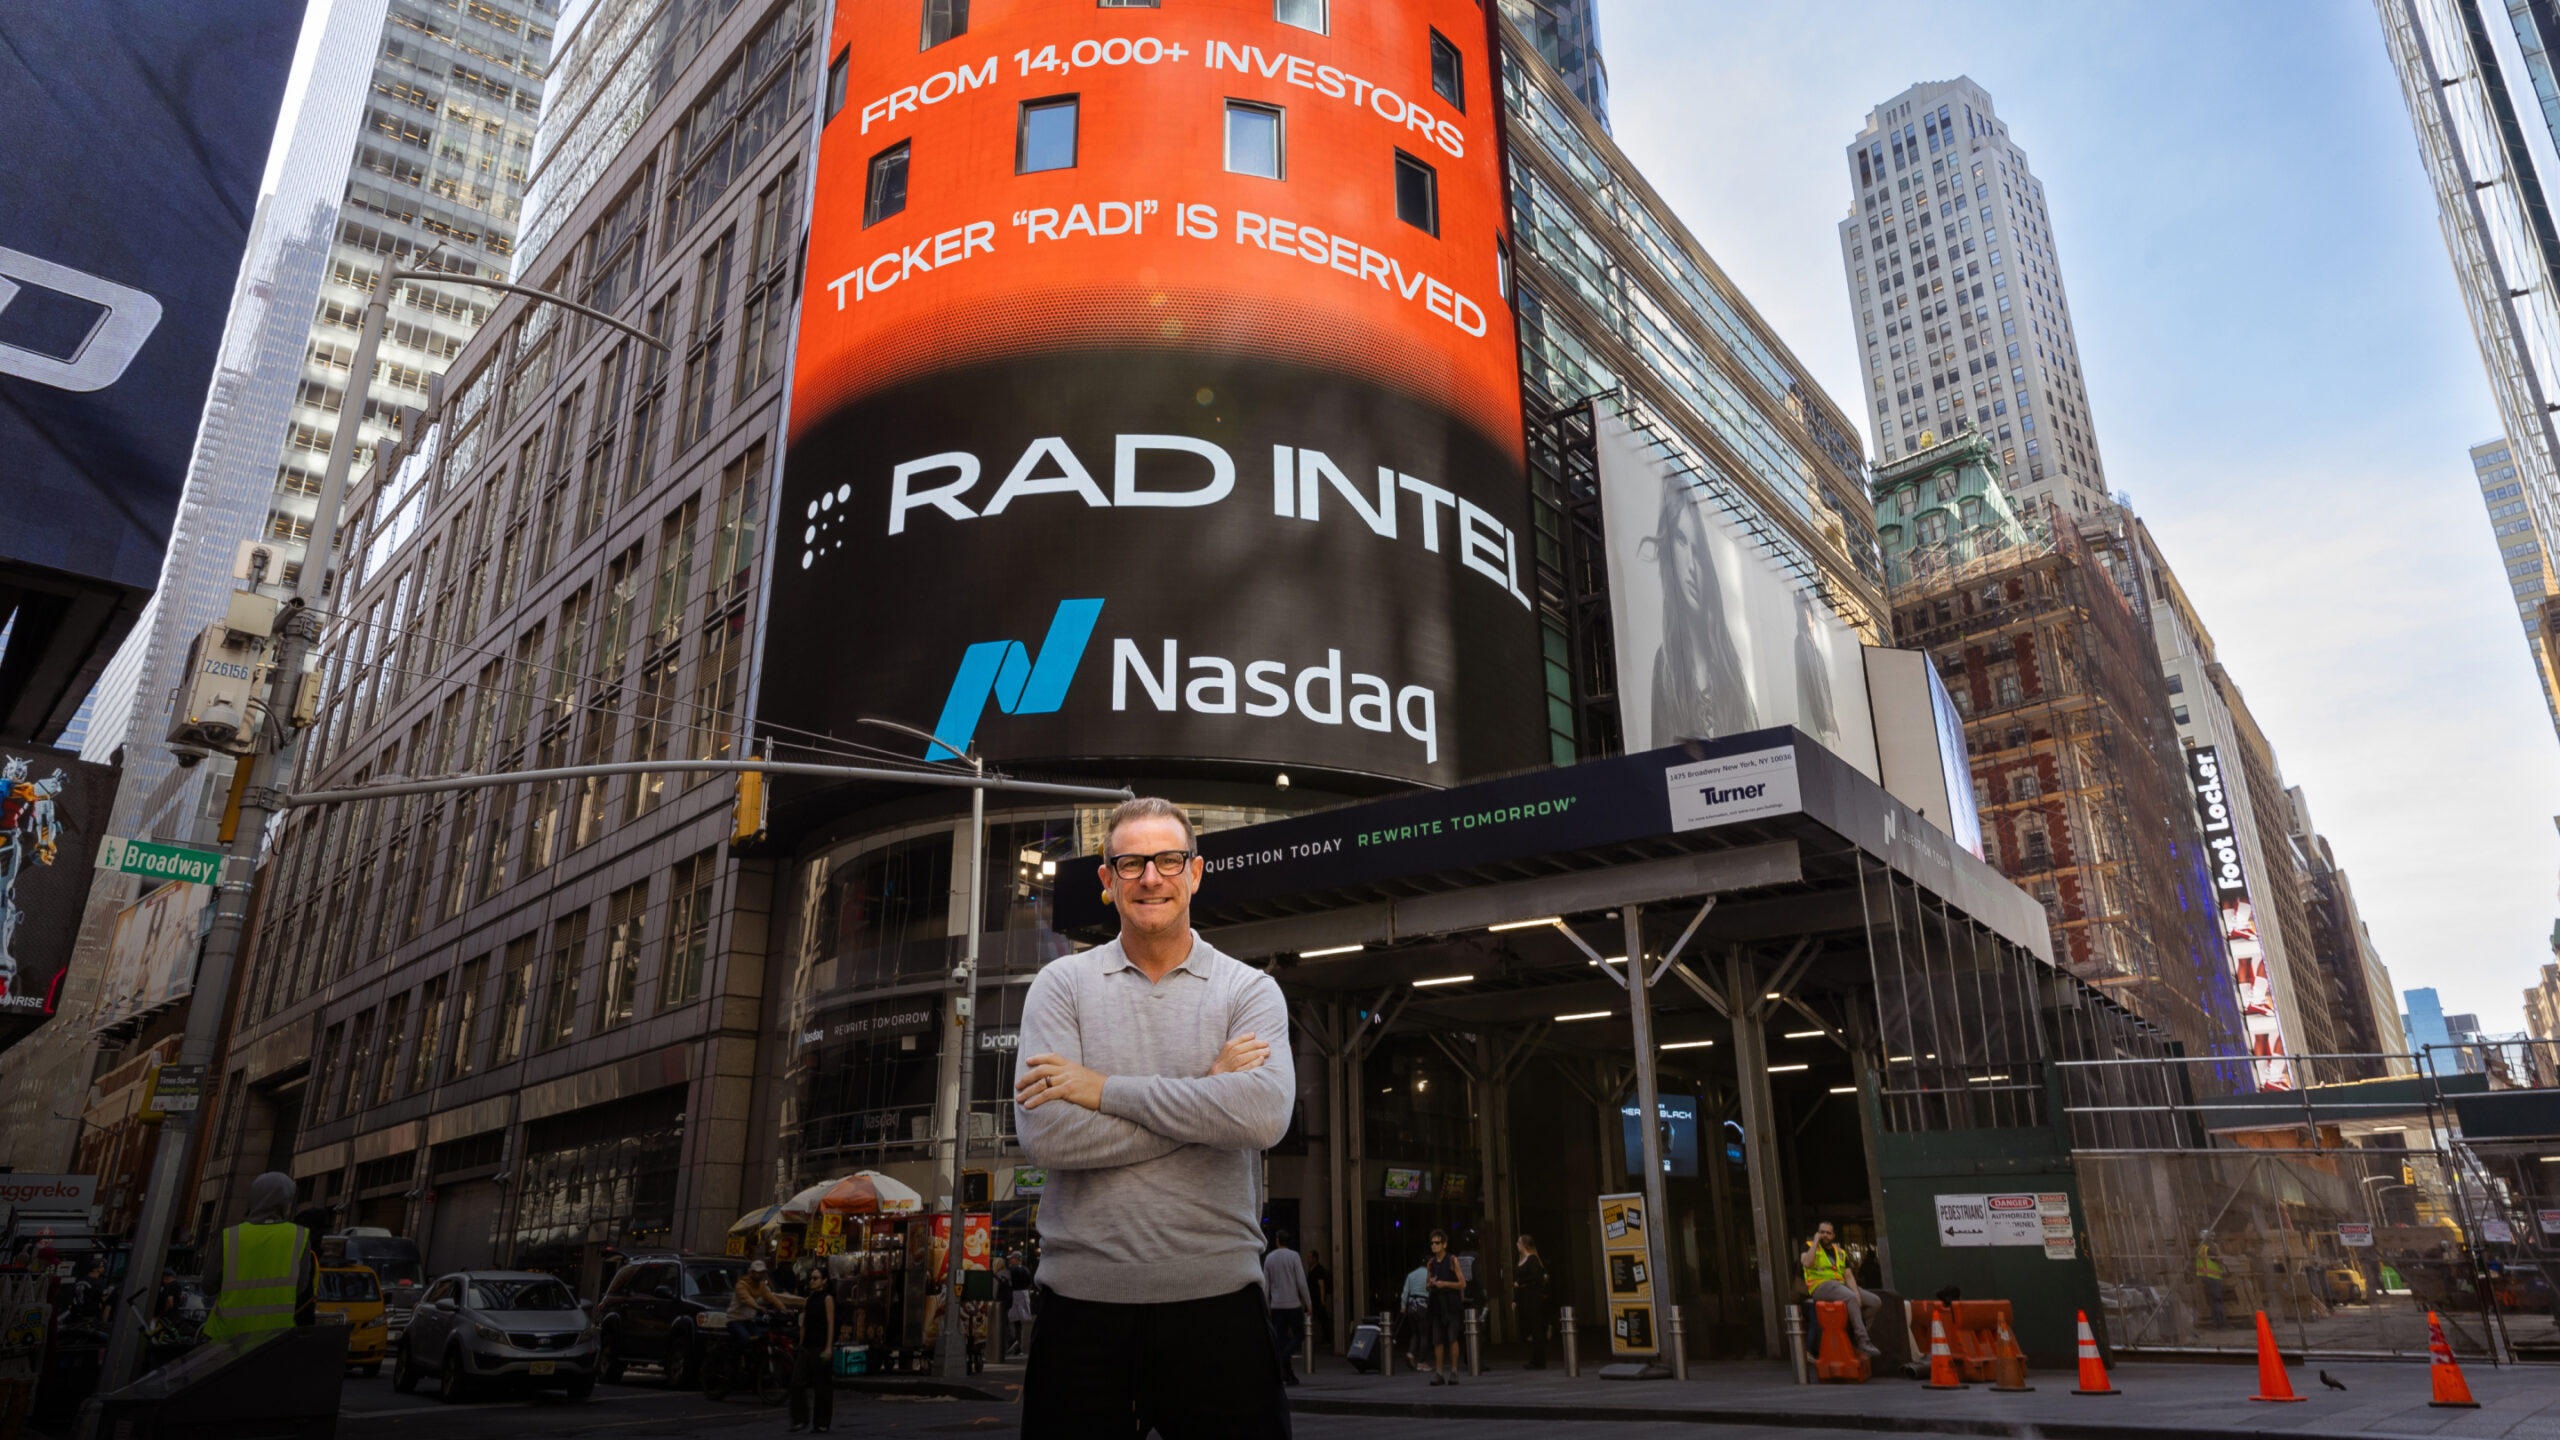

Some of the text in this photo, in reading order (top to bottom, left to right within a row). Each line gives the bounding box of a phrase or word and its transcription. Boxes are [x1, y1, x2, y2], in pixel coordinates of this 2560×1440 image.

[860, 36, 1466, 160] FROM 14,000+ INVESTORS
[826, 220, 996, 312] TICKER
[1175, 202, 1219, 240] IS
[1236, 211, 1486, 339] RESERVED
[888, 434, 1532, 611] RAD INTEL
[205, 658, 249, 681] 726156
[1112, 637, 1438, 765] Nasdaq
[1670, 773, 1687, 782] 1475
[1687, 767, 1722, 779] Broadway
[1722, 763, 1739, 772] New
[1758, 756, 1769, 766] NY
[1770, 753, 1793, 764] 10036
[1699, 782, 1766, 806] Turner
[2196, 752, 2244, 889] Foot Locker
[1204, 848, 1284, 875] QUESTION
[1290, 838, 1343, 860] TODAY
[1357, 820, 1443, 848] REWRITE
[124, 845, 215, 885] Broadway
[834, 1018, 869, 1037] REWRITE
[872, 1011, 930, 1030] TOMORROW
[1659, 1109, 1693, 1120] BLACK
[0, 1180, 81, 1202] aggreko
[1994, 1198, 2029, 1208] DANGER
[1939, 1203, 1985, 1221] PEDESTRIANS
[1991, 1212, 2036, 1220] AUTHORIZED
